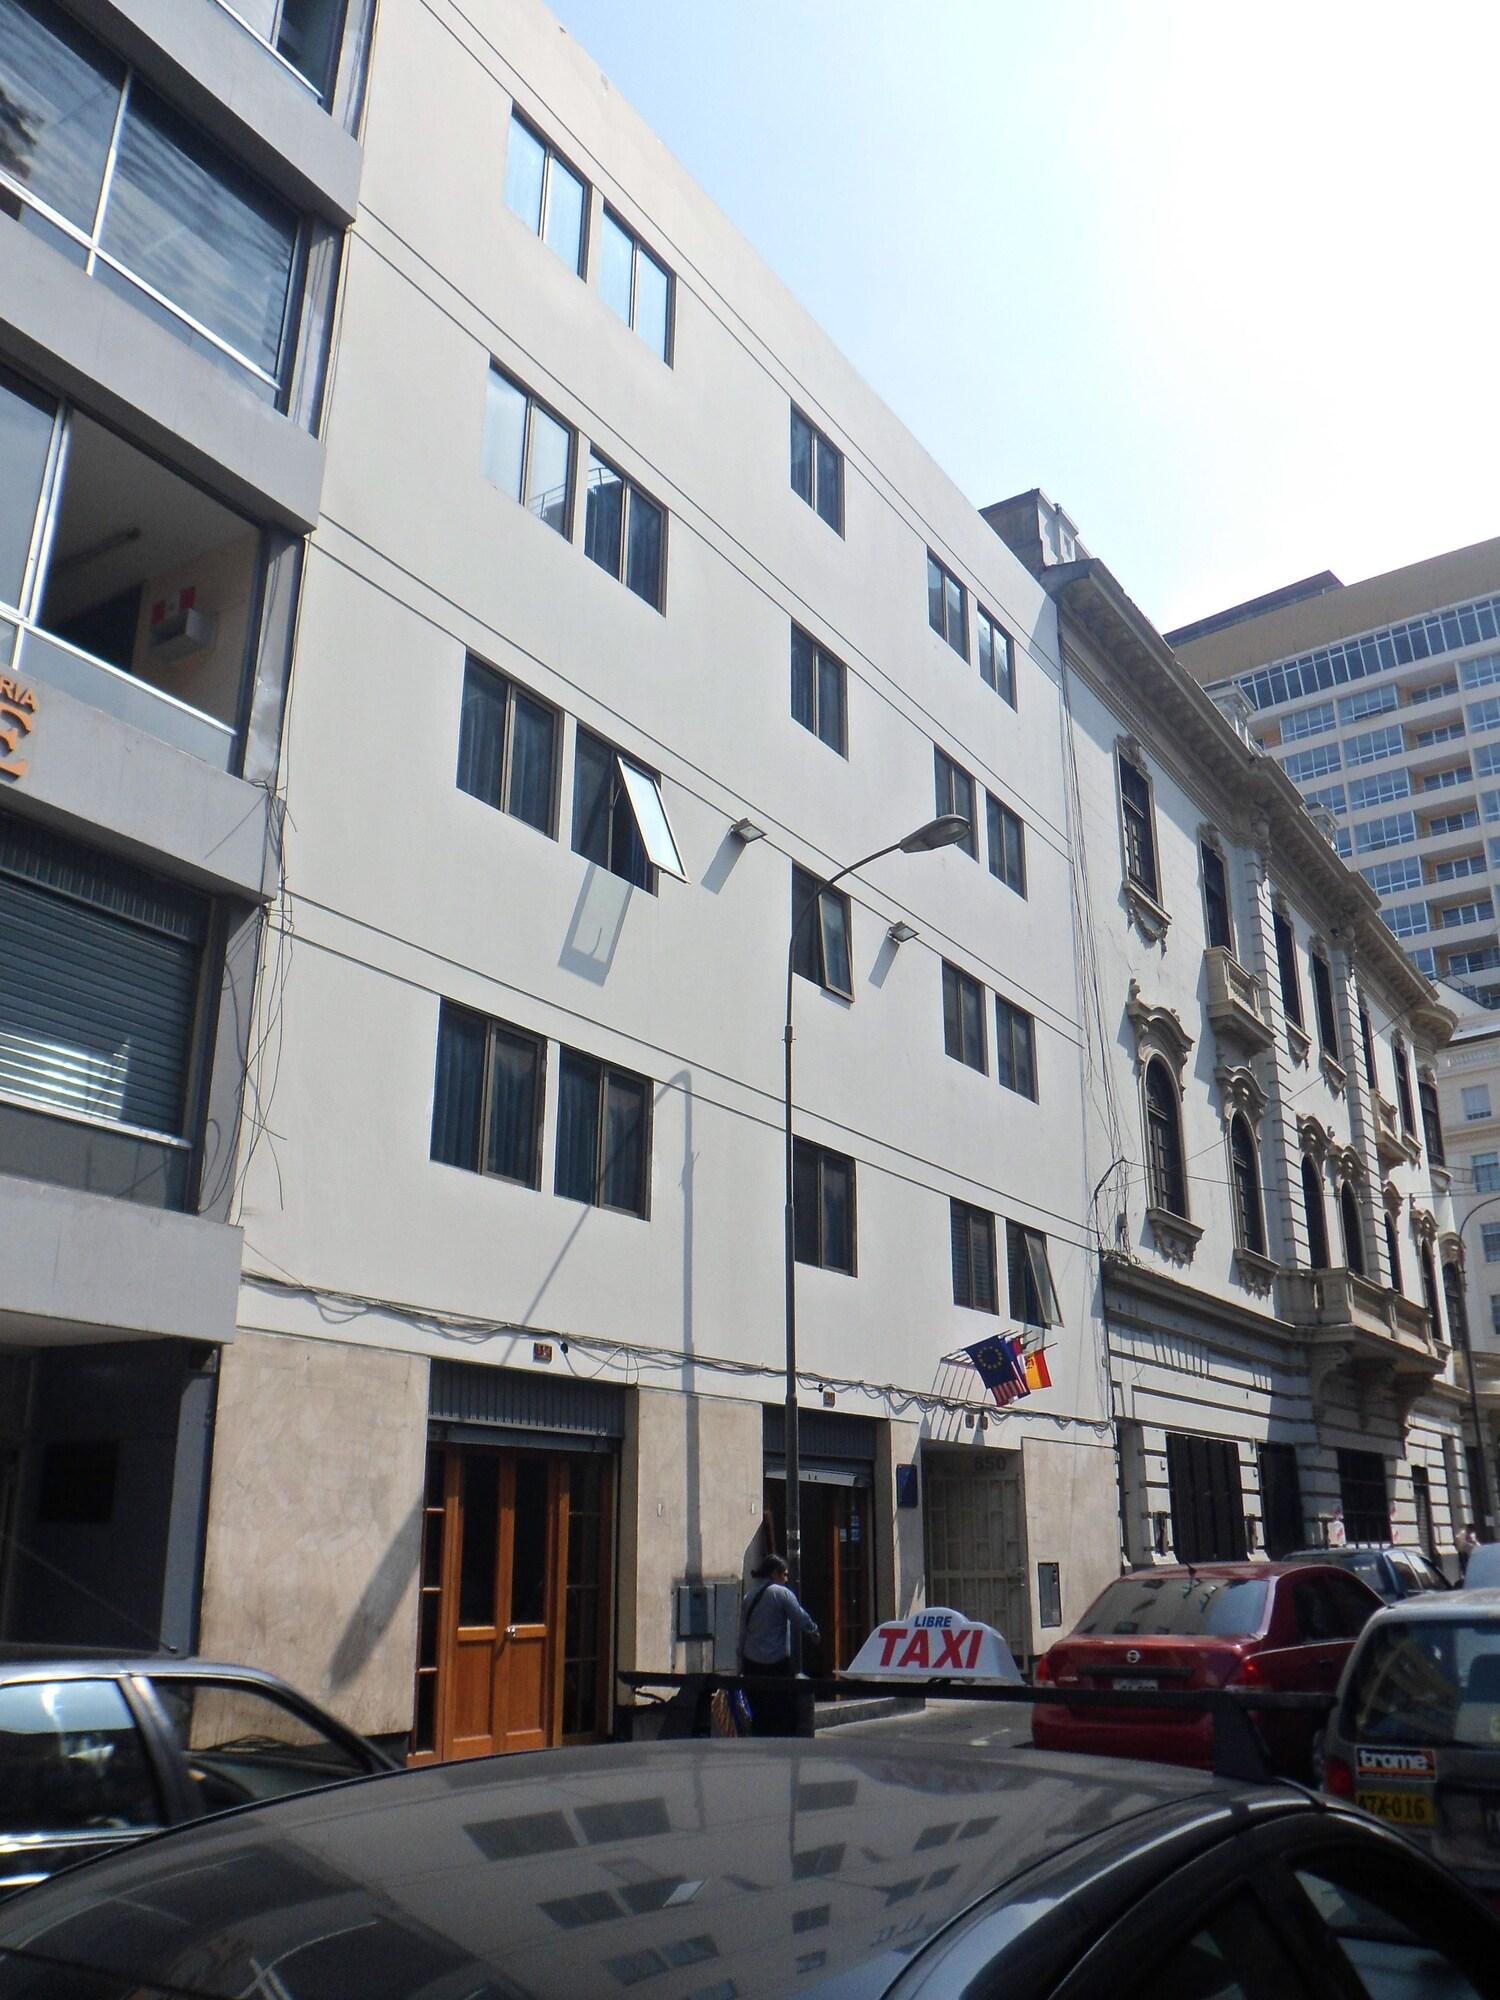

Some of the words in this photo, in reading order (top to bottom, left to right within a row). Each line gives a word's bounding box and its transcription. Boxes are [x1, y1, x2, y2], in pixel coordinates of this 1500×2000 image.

[914, 1615, 952, 1628] LIBRE
[879, 1628, 983, 1669] TAXI
[1360, 1750, 1428, 1771] trome
